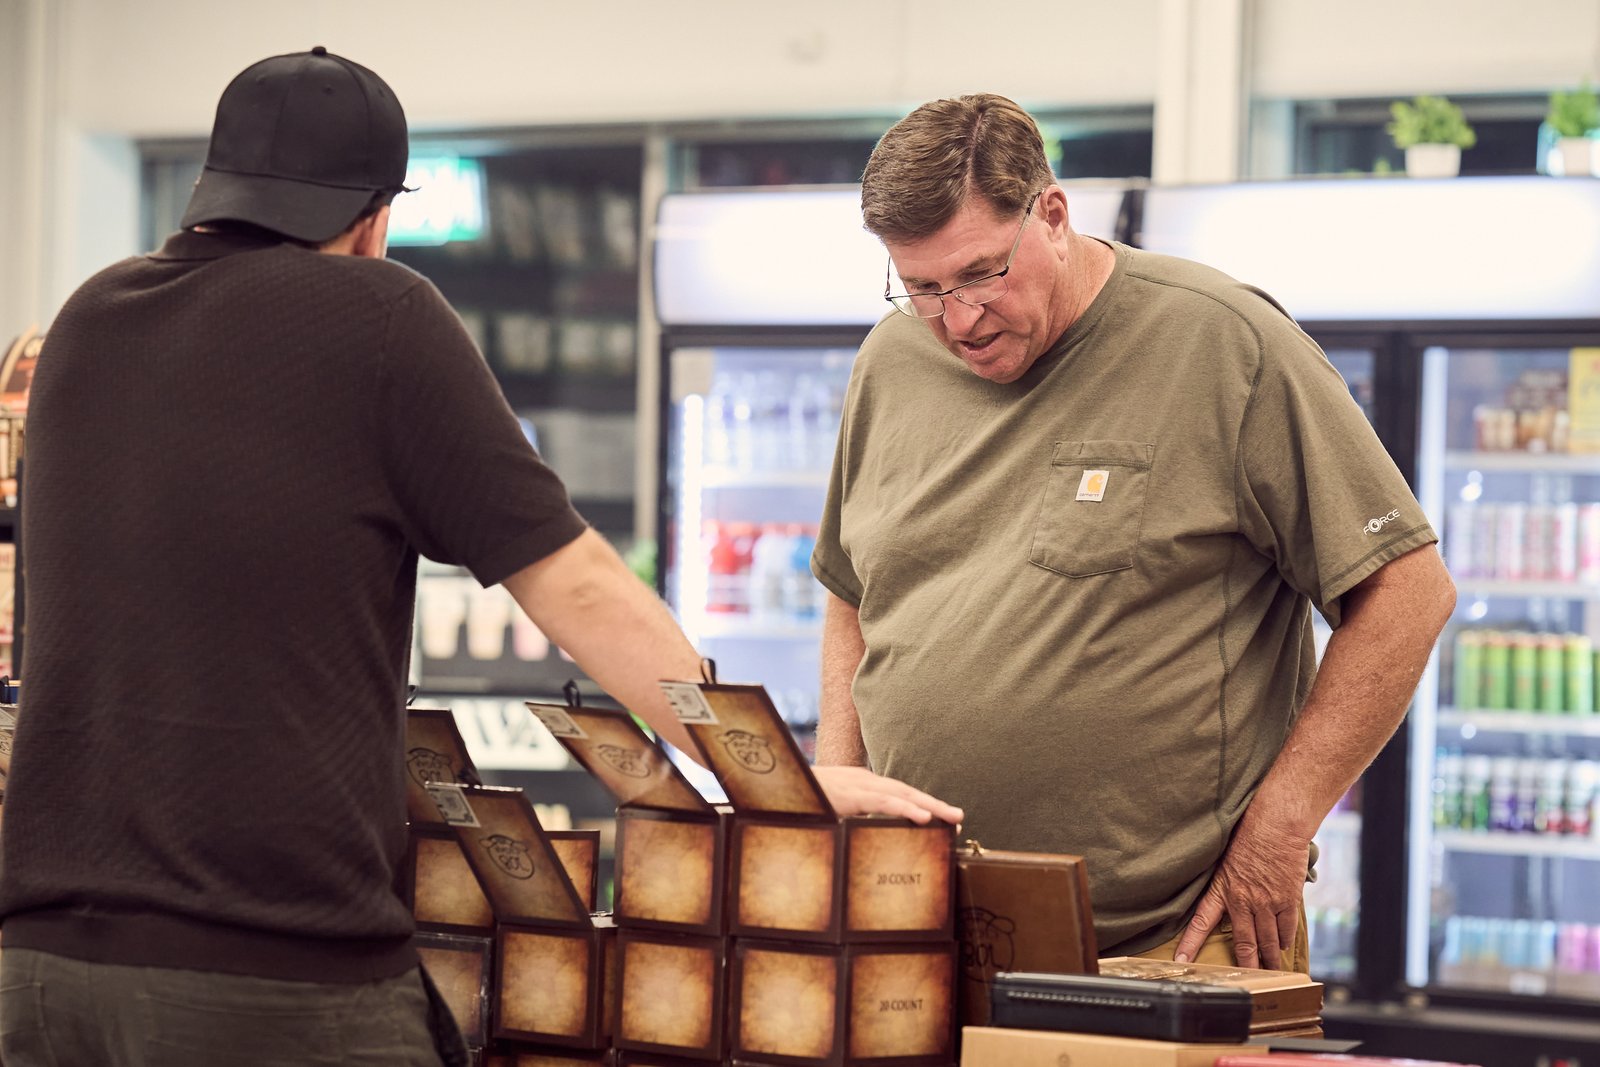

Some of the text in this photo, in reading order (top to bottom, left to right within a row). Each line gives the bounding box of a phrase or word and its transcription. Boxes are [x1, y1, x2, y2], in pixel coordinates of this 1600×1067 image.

[1363, 508, 1401, 536] FORCE
[877, 873, 922, 885] 20 COUNT
[879, 998, 924, 1012] 20 COUNT
